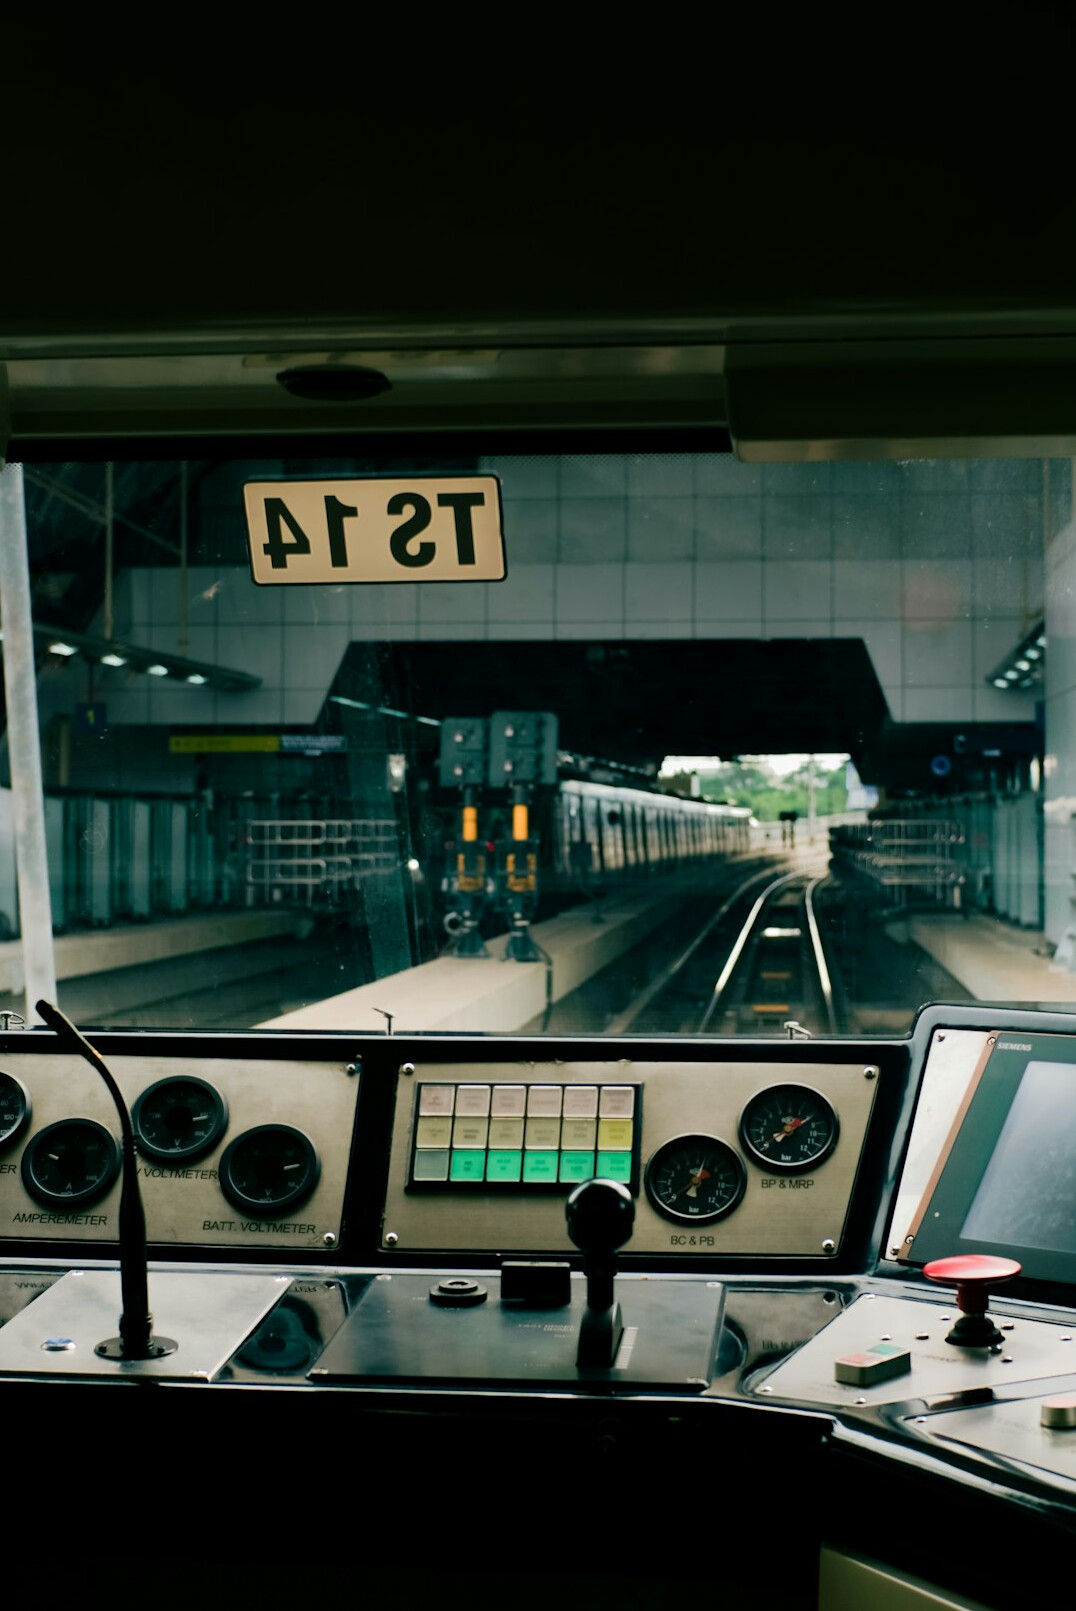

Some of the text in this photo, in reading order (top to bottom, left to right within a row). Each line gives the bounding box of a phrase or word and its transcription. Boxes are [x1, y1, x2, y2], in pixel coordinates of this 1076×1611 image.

[997, 1042, 1032, 1052] SIEMENS
[781, 1153, 792, 1161] bar
[143, 1168, 218, 1180] VOLTMETER
[761, 1179, 814, 1189] BP & MRP
[13, 1213, 107, 1225] AMPEREMETER
[203, 1220, 316, 1234] BATT. VOLTMETER
[671, 1235, 715, 1246] BC & PB
